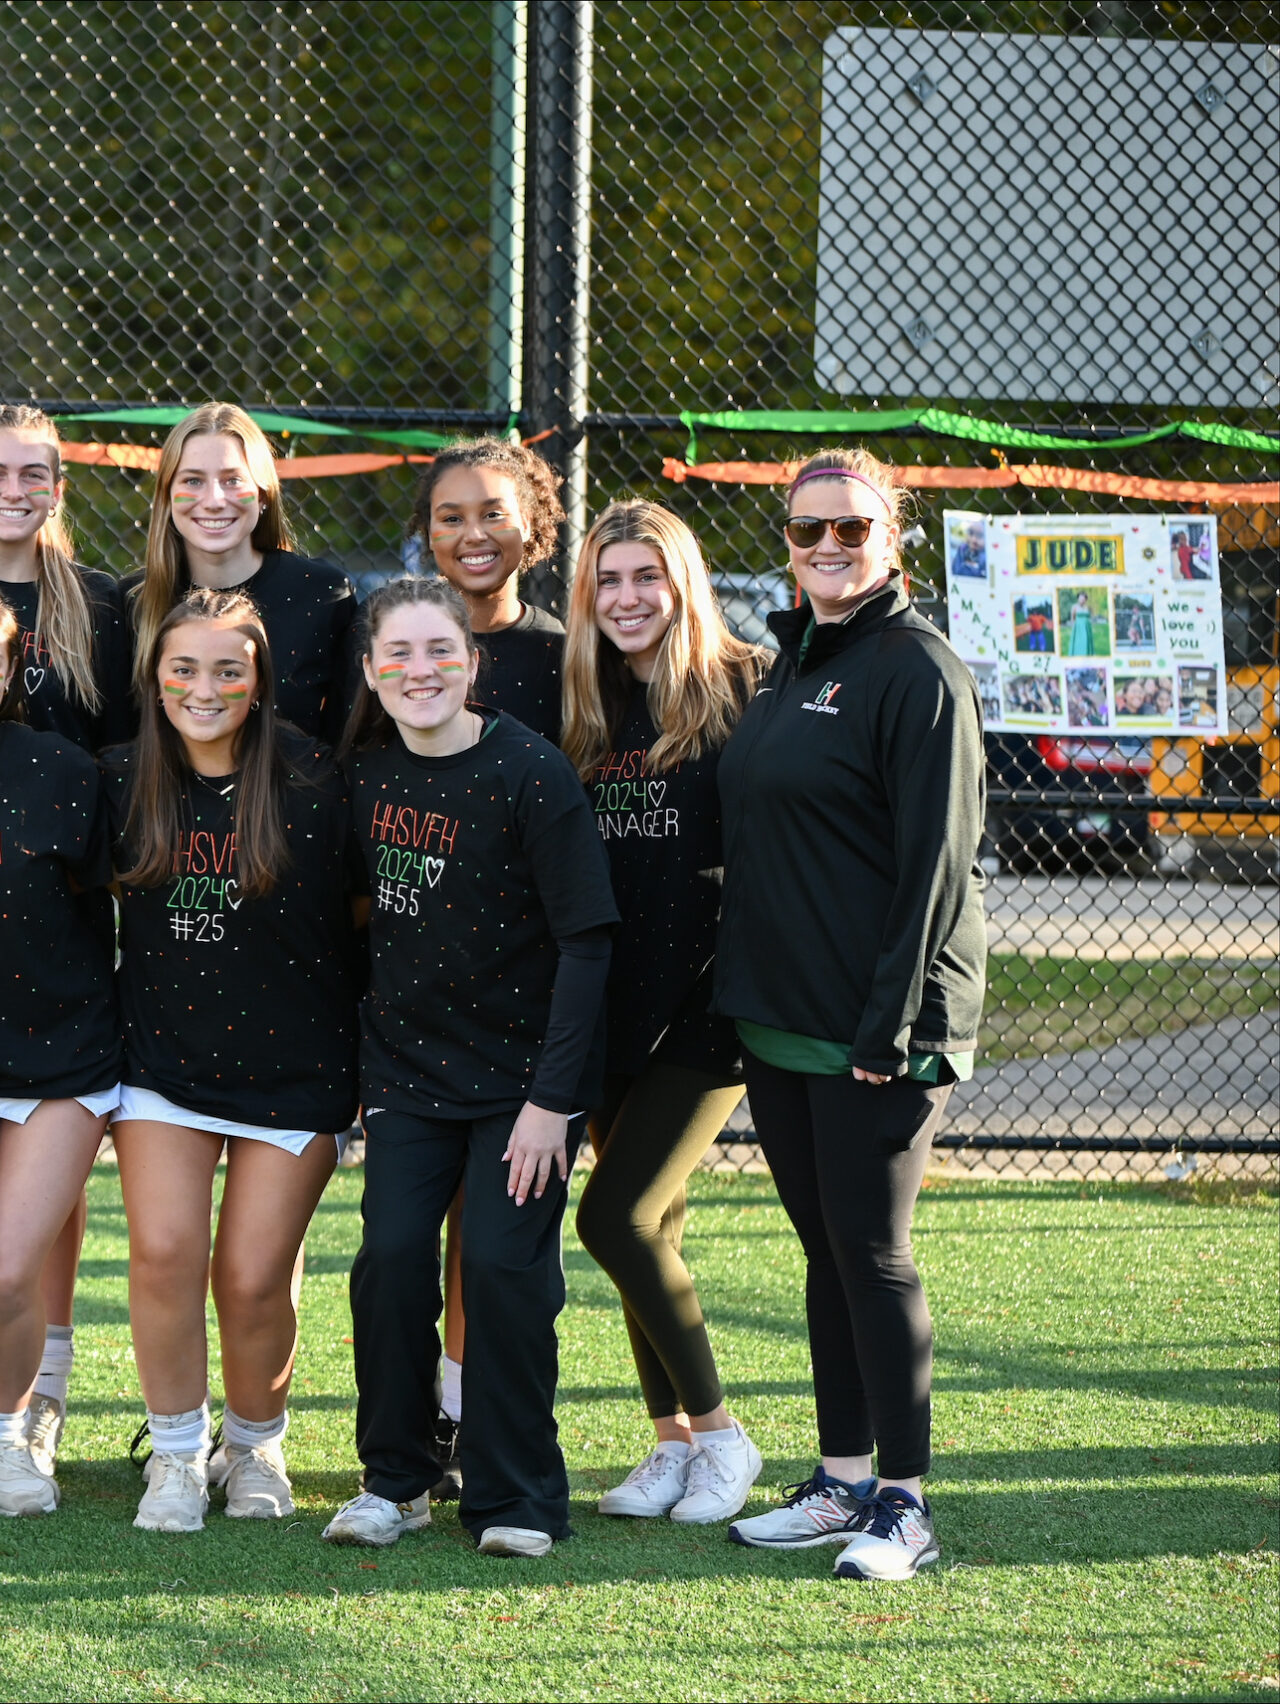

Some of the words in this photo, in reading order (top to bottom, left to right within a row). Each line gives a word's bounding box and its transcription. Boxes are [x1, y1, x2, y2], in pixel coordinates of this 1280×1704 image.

[1023, 538, 1116, 572] JUDE
[1161, 618, 1195, 632] love
[1169, 637, 1200, 650] you
[594, 781, 648, 812] 2024
[370, 800, 459, 855] HHSVFH
[597, 808, 679, 840] ANAGER
[376, 844, 426, 886] 2024
[166, 875, 225, 910] 2024
[377, 878, 420, 916] #55
[169, 911, 225, 942] #25
